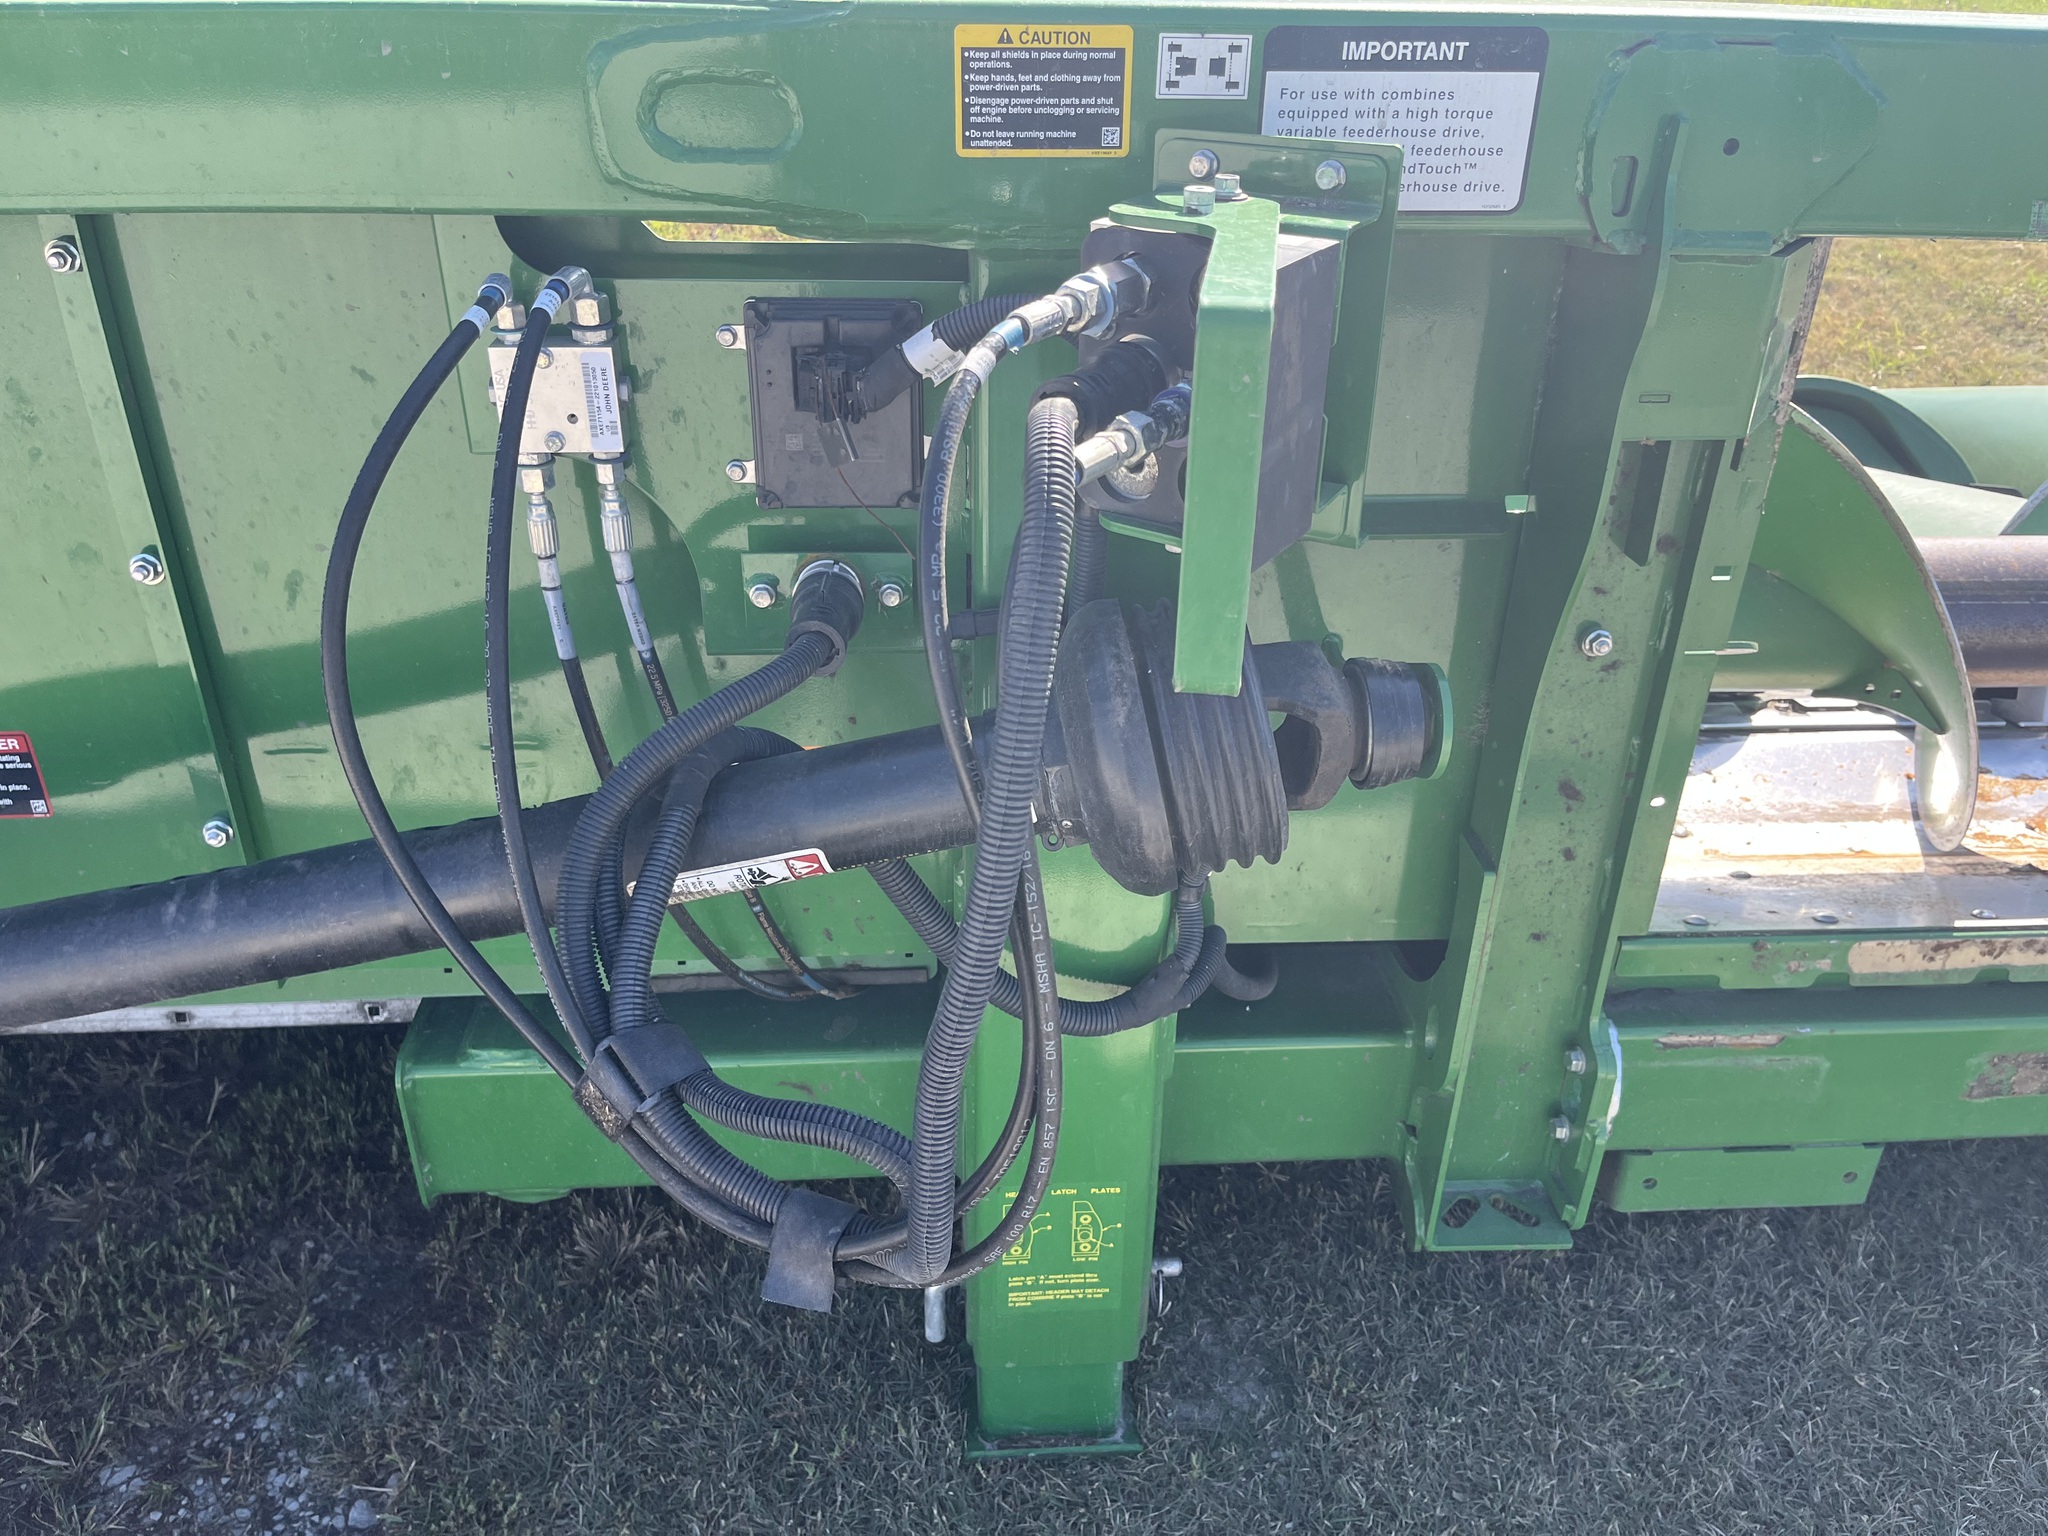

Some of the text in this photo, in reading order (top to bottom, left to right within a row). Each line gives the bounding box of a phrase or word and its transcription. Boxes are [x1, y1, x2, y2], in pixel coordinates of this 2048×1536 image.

[1019, 31, 1090, 44] CAUTION
[1041, 51, 1061, 60] place
[1063, 51, 1087, 60] during
[1341, 41, 1469, 61] IMPORTANT
[970, 74, 989, 82] Keep
[991, 74, 1016, 82] hands,
[1051, 74, 1080, 83] clothing
[1281, 88, 1454, 100] For use with combines
[970, 97, 1009, 106] Disengage
[982, 106, 1006, 115] engine
[1034, 106, 1074, 115] unclogging
[1086, 107, 1119, 115] servicing
[1278, 107, 1348, 121] equipped
[1355, 107, 1385, 119] with
[1406, 108, 1438, 122] high
[1445, 108, 1493, 122] torque
[1017, 131, 1044, 139] running
[1278, 126, 1484, 139] variable feederhouse drive,
[1411, 145, 1503, 156] feederhouse
[1402, 163, 1477, 174] ndTouch™
[1400, 181, 1504, 192] erhouse drive.
[600, 367, 610, 391] DEERE
[647, 664, 658, 680] 22.5
[653, 680, 663, 695] MPa
[0, 739, 19, 750] ER
[1022, 850, 1043, 941] IC-152/16
[1035, 952, 1050, 993] MSHA
[1044, 1021, 1054, 1032] 6
[1046, 1041, 1056, 1060] DN
[1043, 1123, 1056, 1148] 857
[1038, 1158, 1050, 1175] EN
[1021, 1195, 1037, 1219] R17
[1005, 1224, 1024, 1242] 100
[985, 1245, 1004, 1264] SAE
